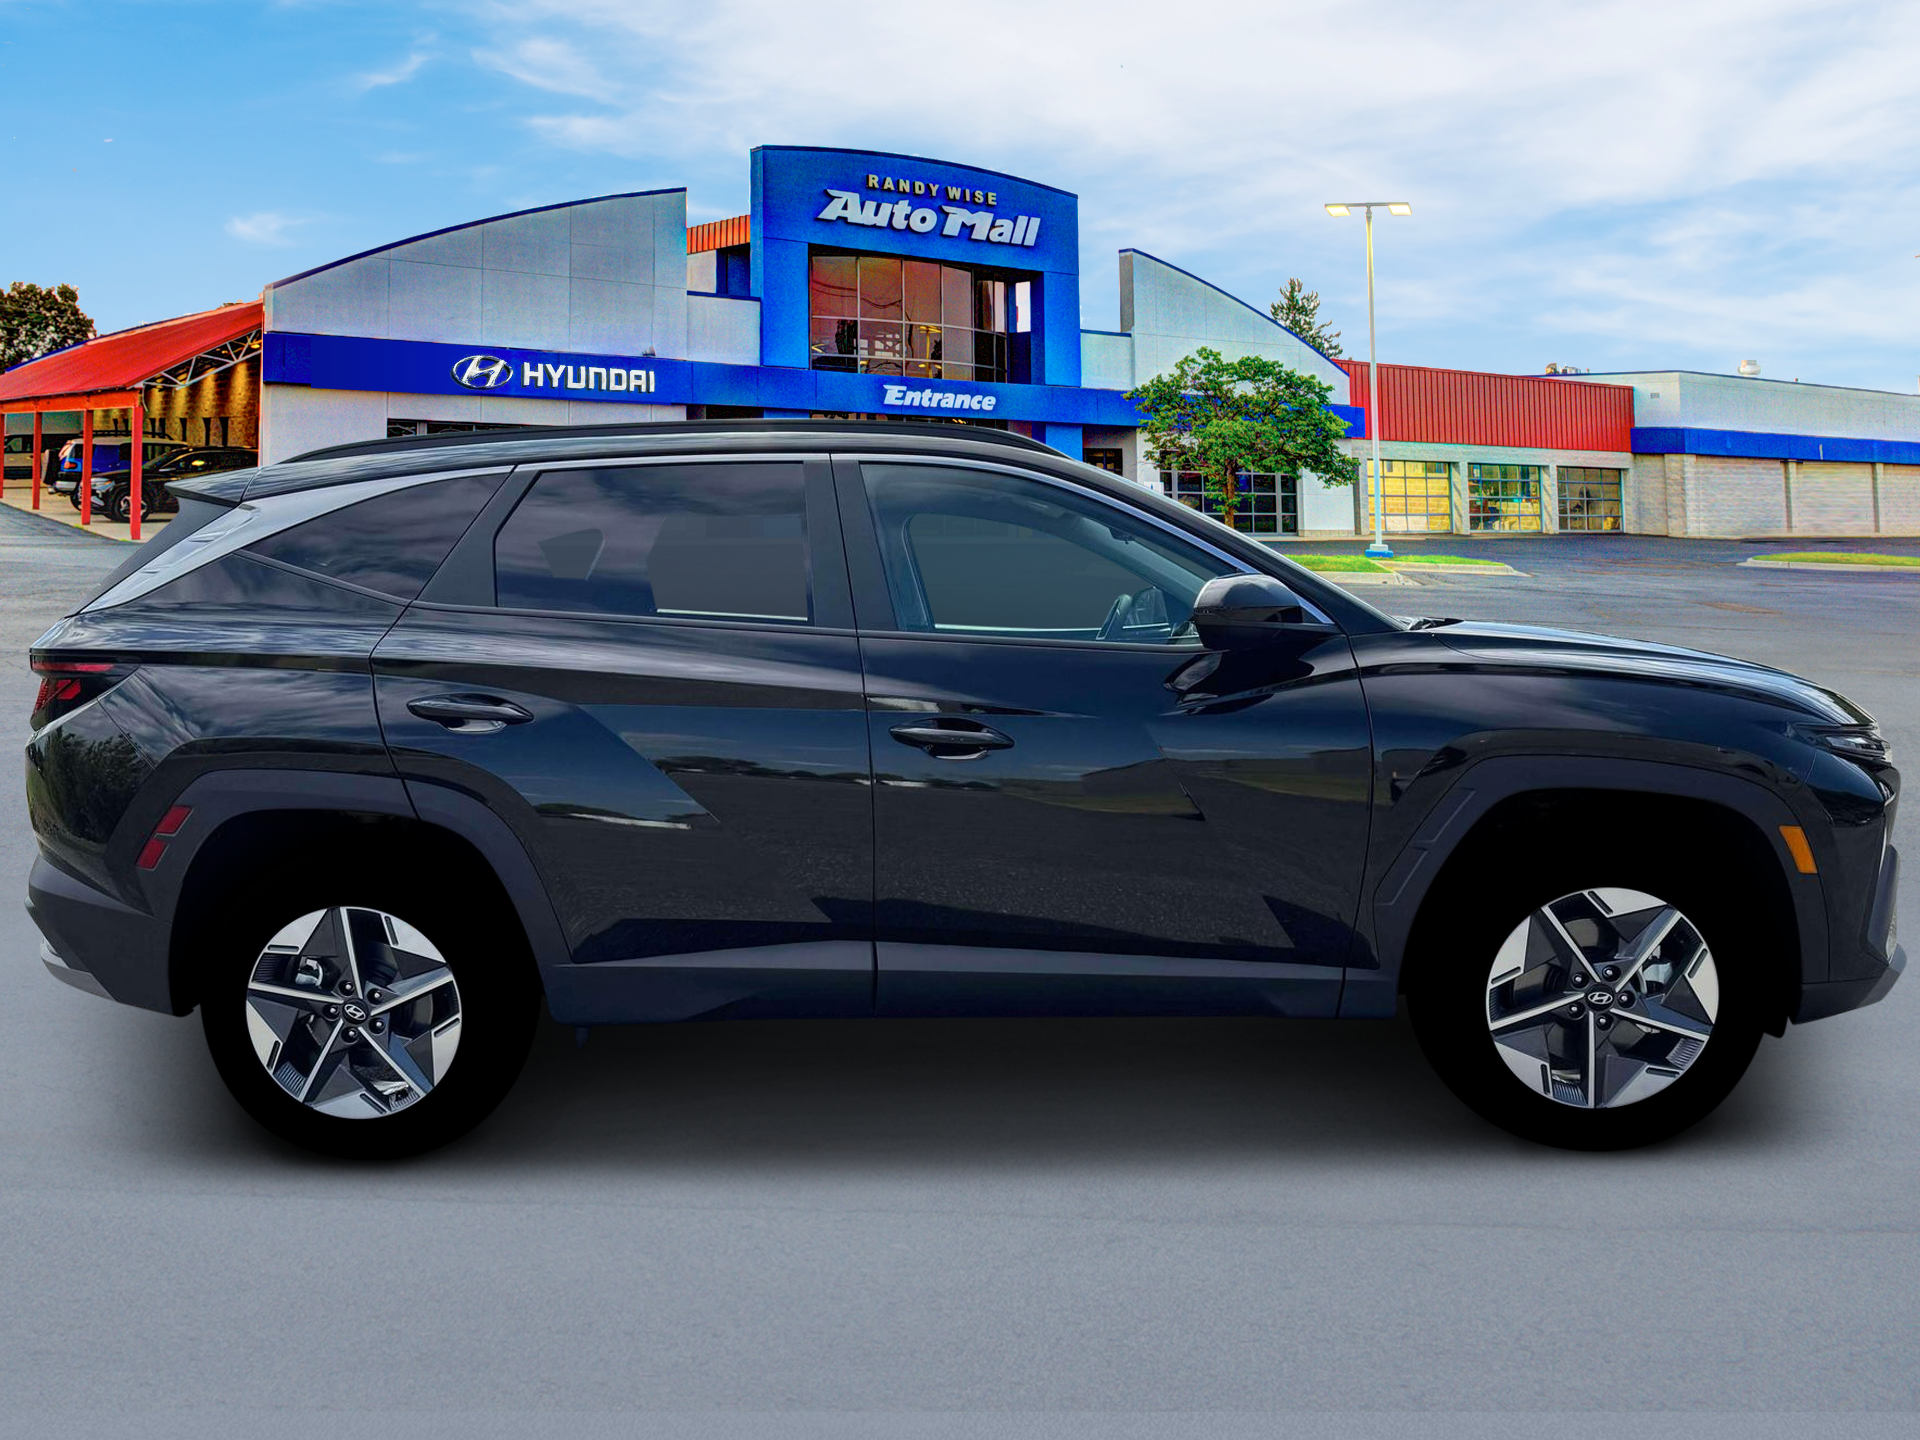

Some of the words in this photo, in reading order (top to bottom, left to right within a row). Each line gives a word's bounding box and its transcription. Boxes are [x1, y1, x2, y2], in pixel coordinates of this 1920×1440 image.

[867, 174, 939, 197] RANDY
[946, 185, 998, 206] WISE
[817, 188, 938, 233] Auto
[941, 204, 1041, 247] Mall
[522, 361, 655, 393] HYUNDAI
[883, 384, 997, 411] Entrance
